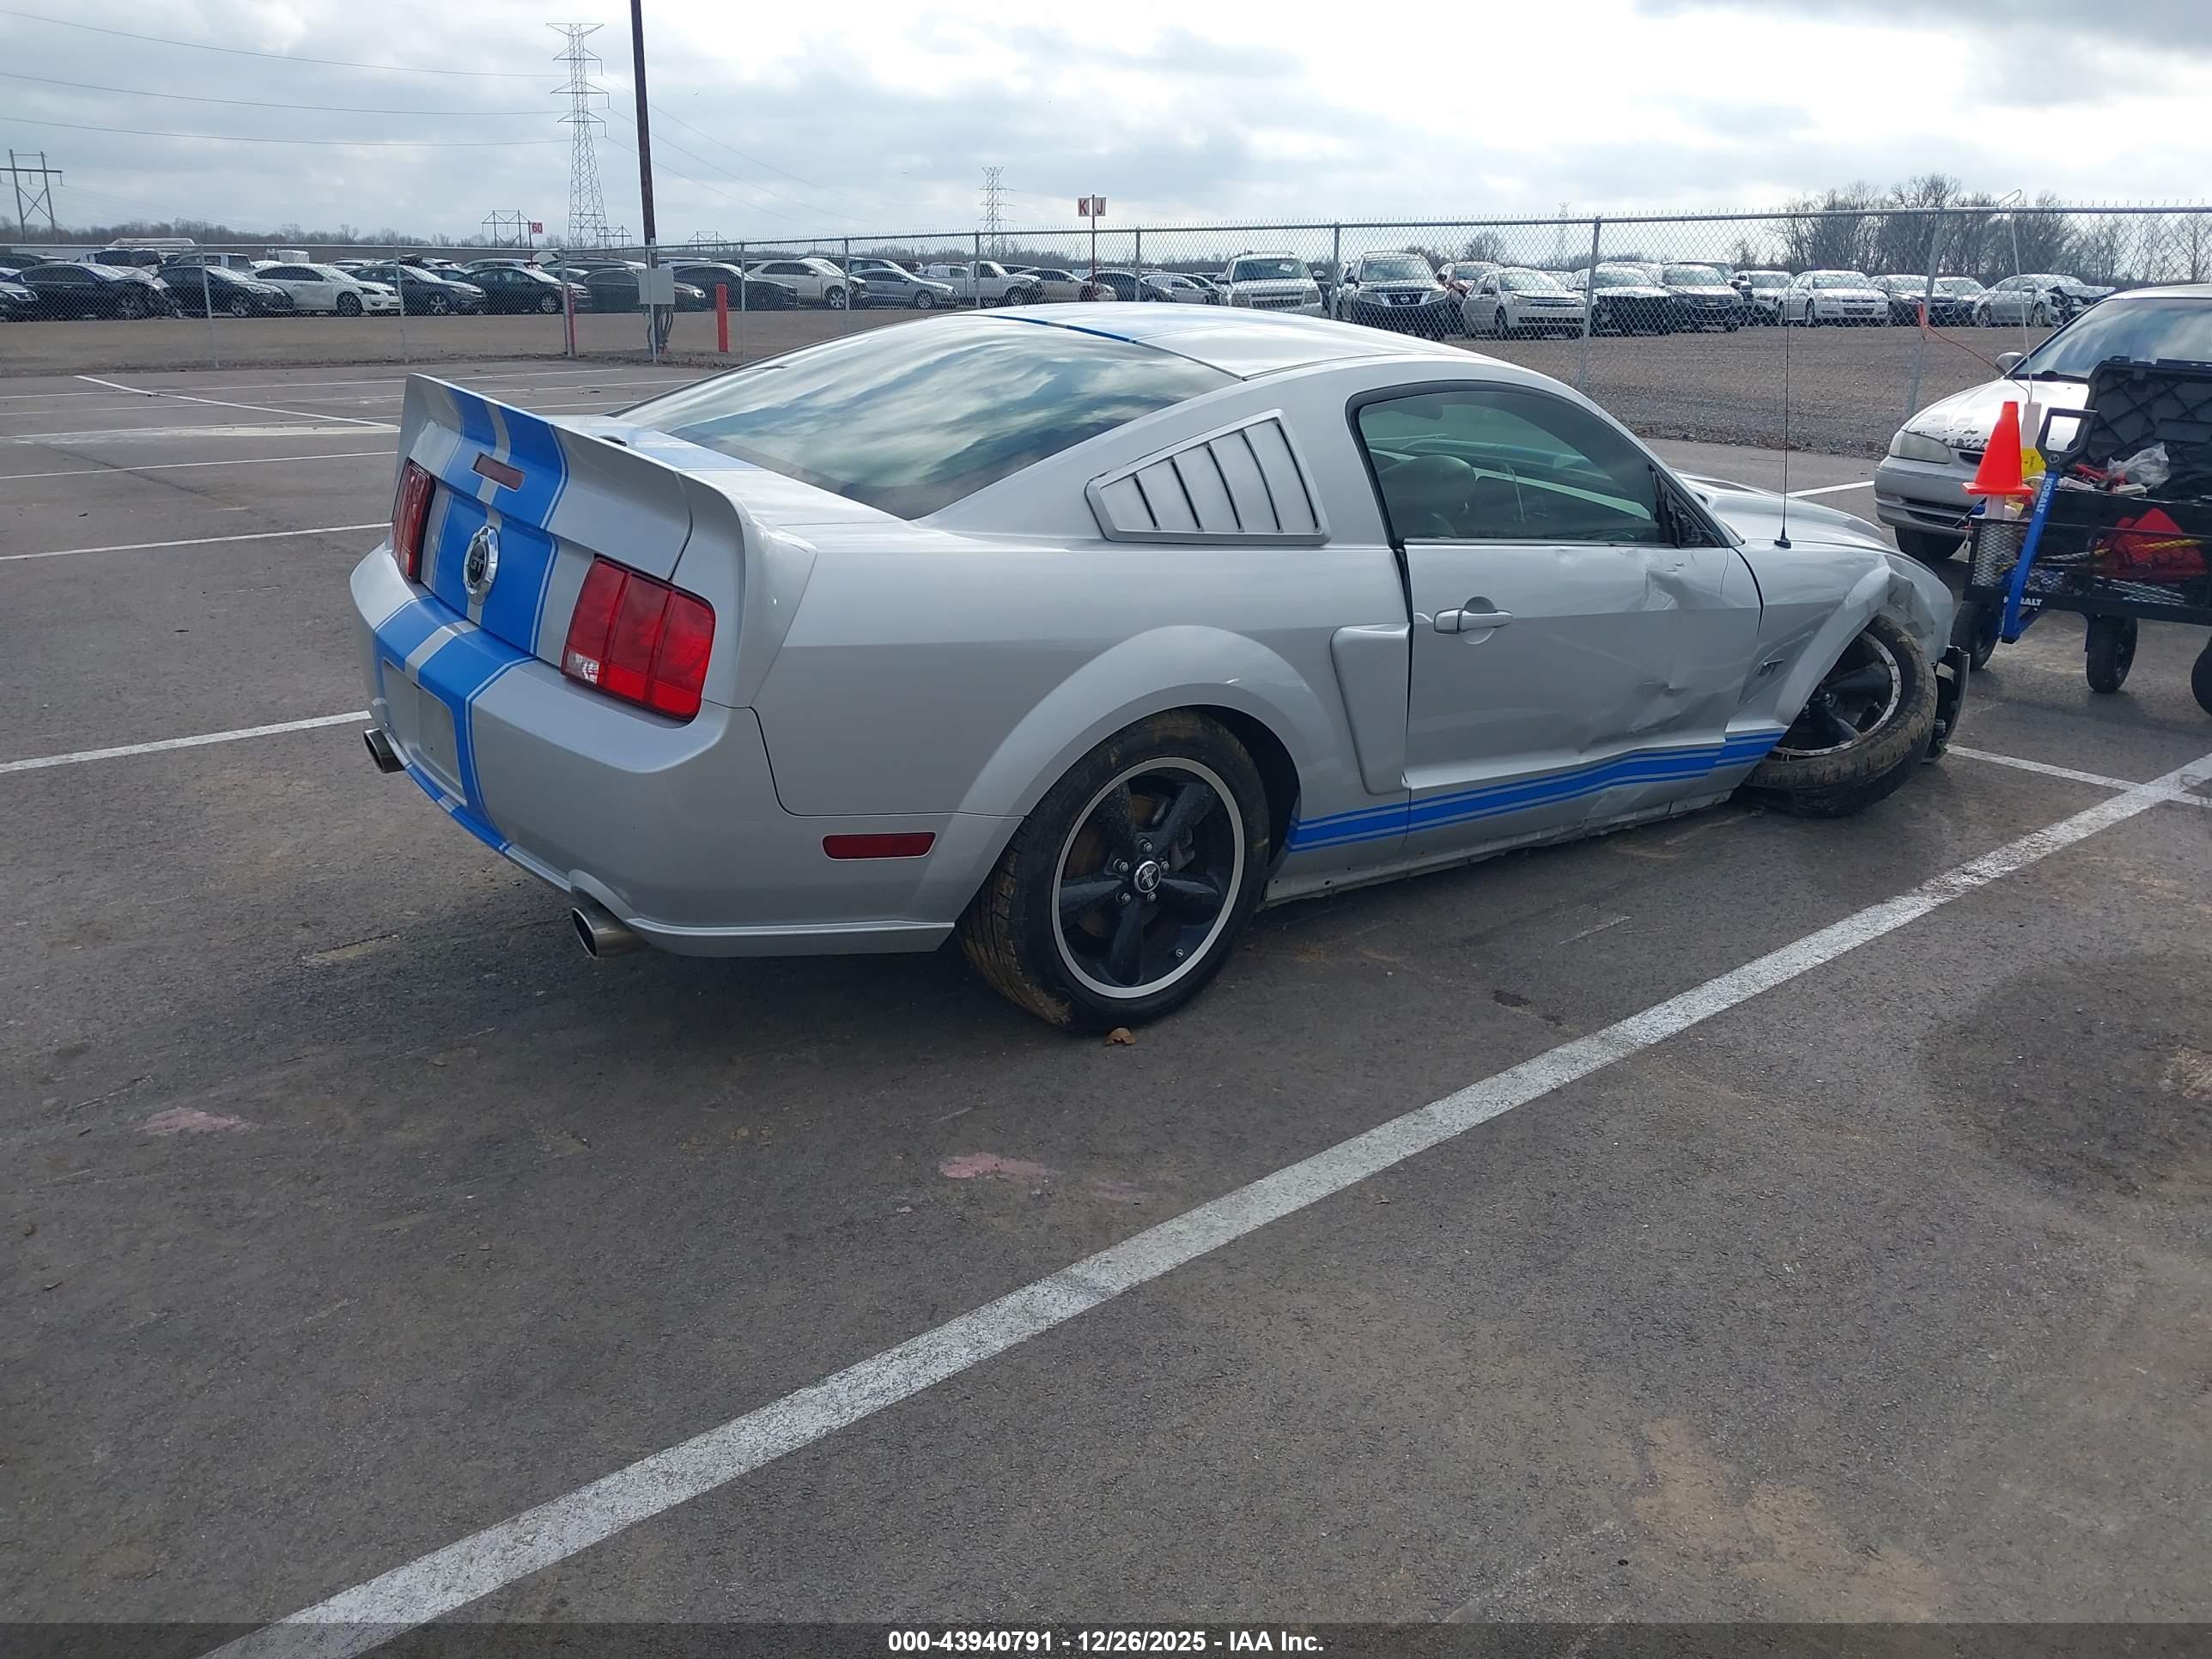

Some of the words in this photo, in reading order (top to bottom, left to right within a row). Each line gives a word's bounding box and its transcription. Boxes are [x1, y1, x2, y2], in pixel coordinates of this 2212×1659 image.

[1079, 199, 1087, 215] K
[1097, 198, 1103, 215] J
[532, 222, 543, 233] 60
[2035, 477, 2055, 514] KOBALT
